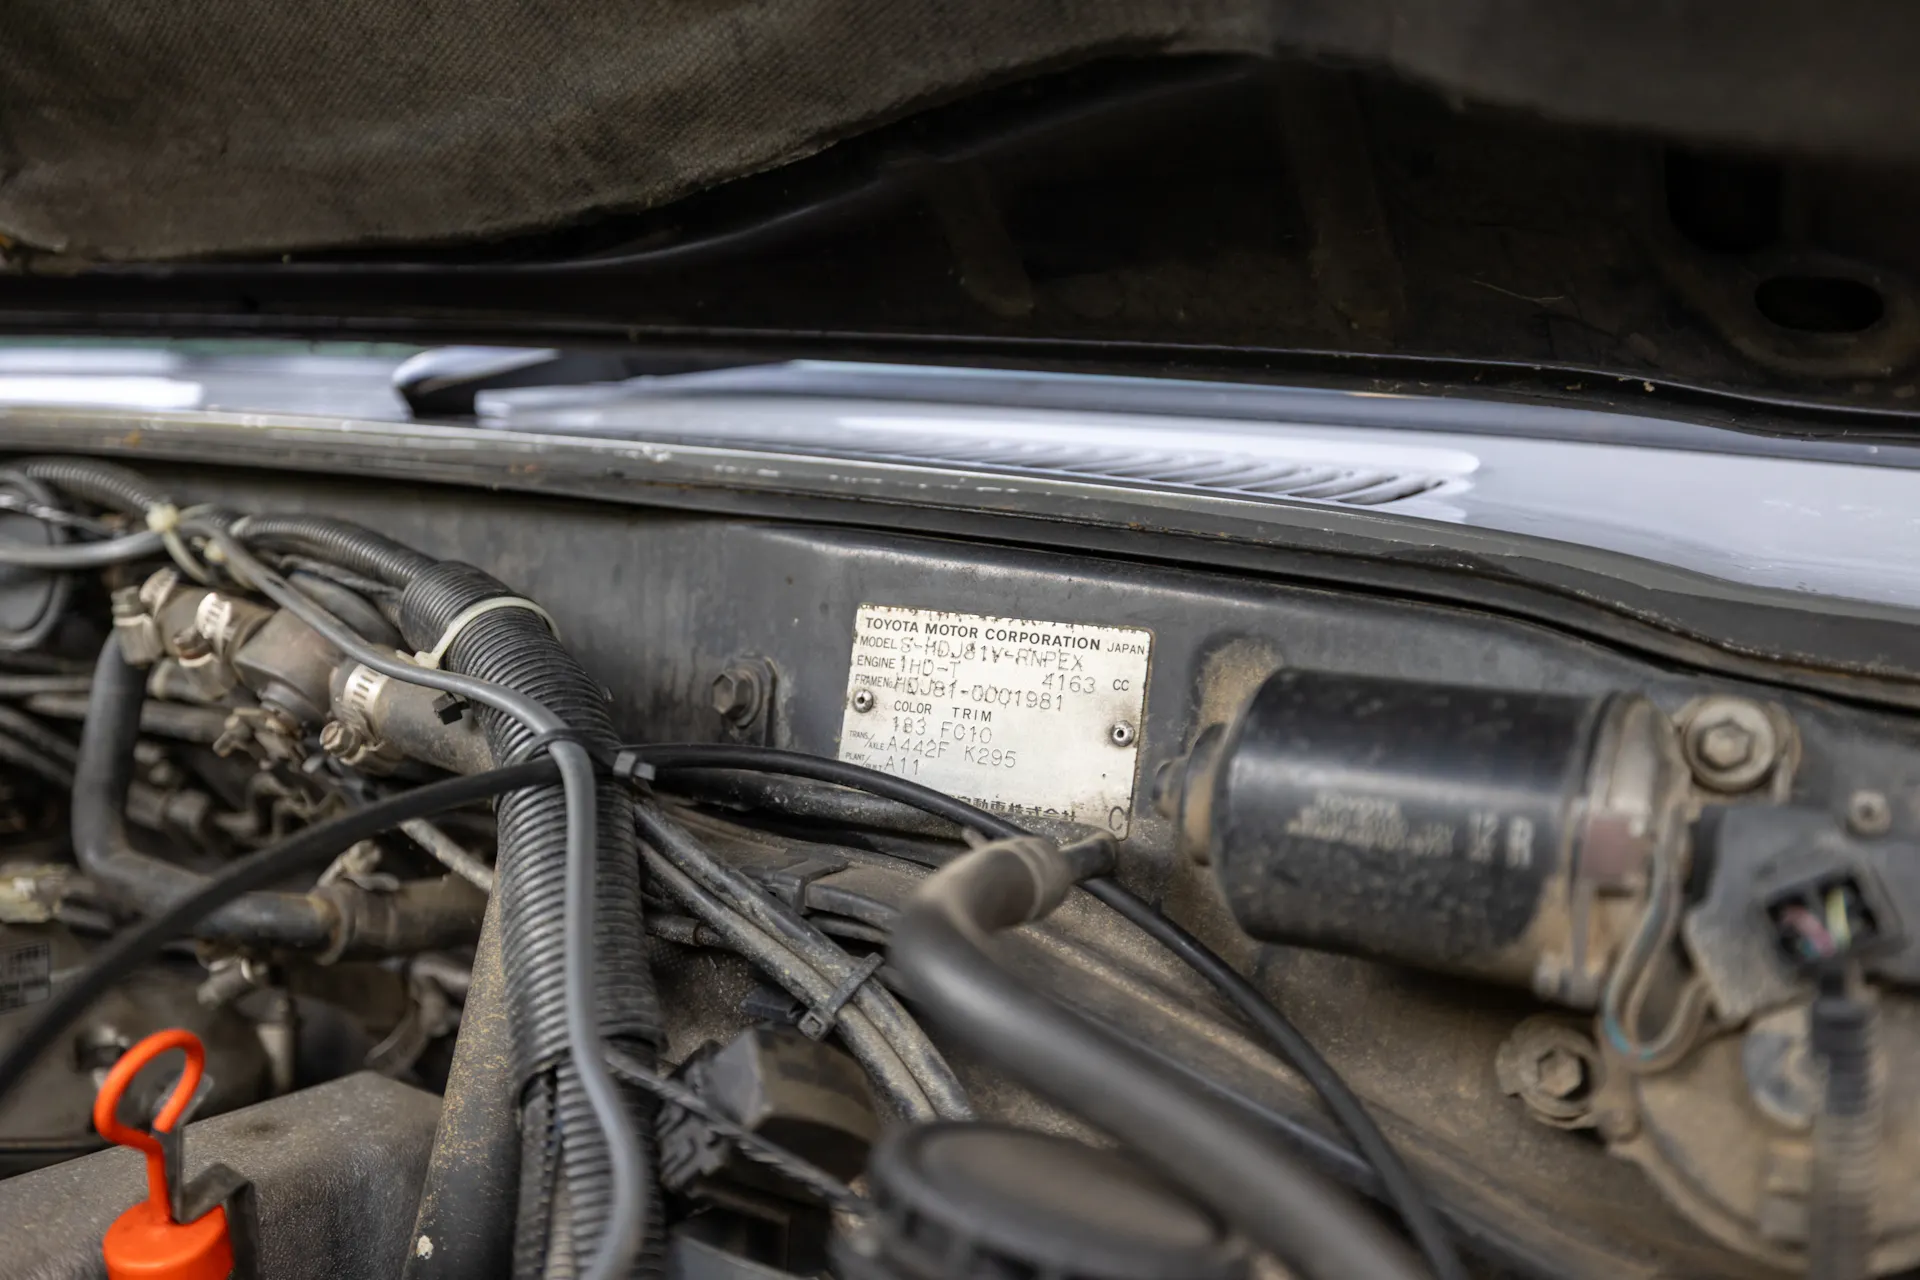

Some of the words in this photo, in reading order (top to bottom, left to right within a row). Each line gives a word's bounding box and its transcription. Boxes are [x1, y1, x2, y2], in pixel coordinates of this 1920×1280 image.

[859, 635, 898, 650] MODEL
[865, 617, 919, 633] TOYOTA
[924, 623, 978, 639] MOTOR
[985, 628, 1101, 650] CORPORATION
[1107, 642, 1145, 655] JAPAN
[857, 654, 896, 669] ENGINE
[901, 655, 961, 678] 1HD-T
[1041, 672, 1097, 694] 4163
[895, 674, 1063, 711] HDJ81-0001981
[894, 700, 932, 715] COLOR
[951, 707, 992, 722] TRIM
[892, 716, 927, 736] 183
[884, 755, 920, 775] A11
[887, 736, 950, 759] A442F
[964, 746, 1017, 769] K295
